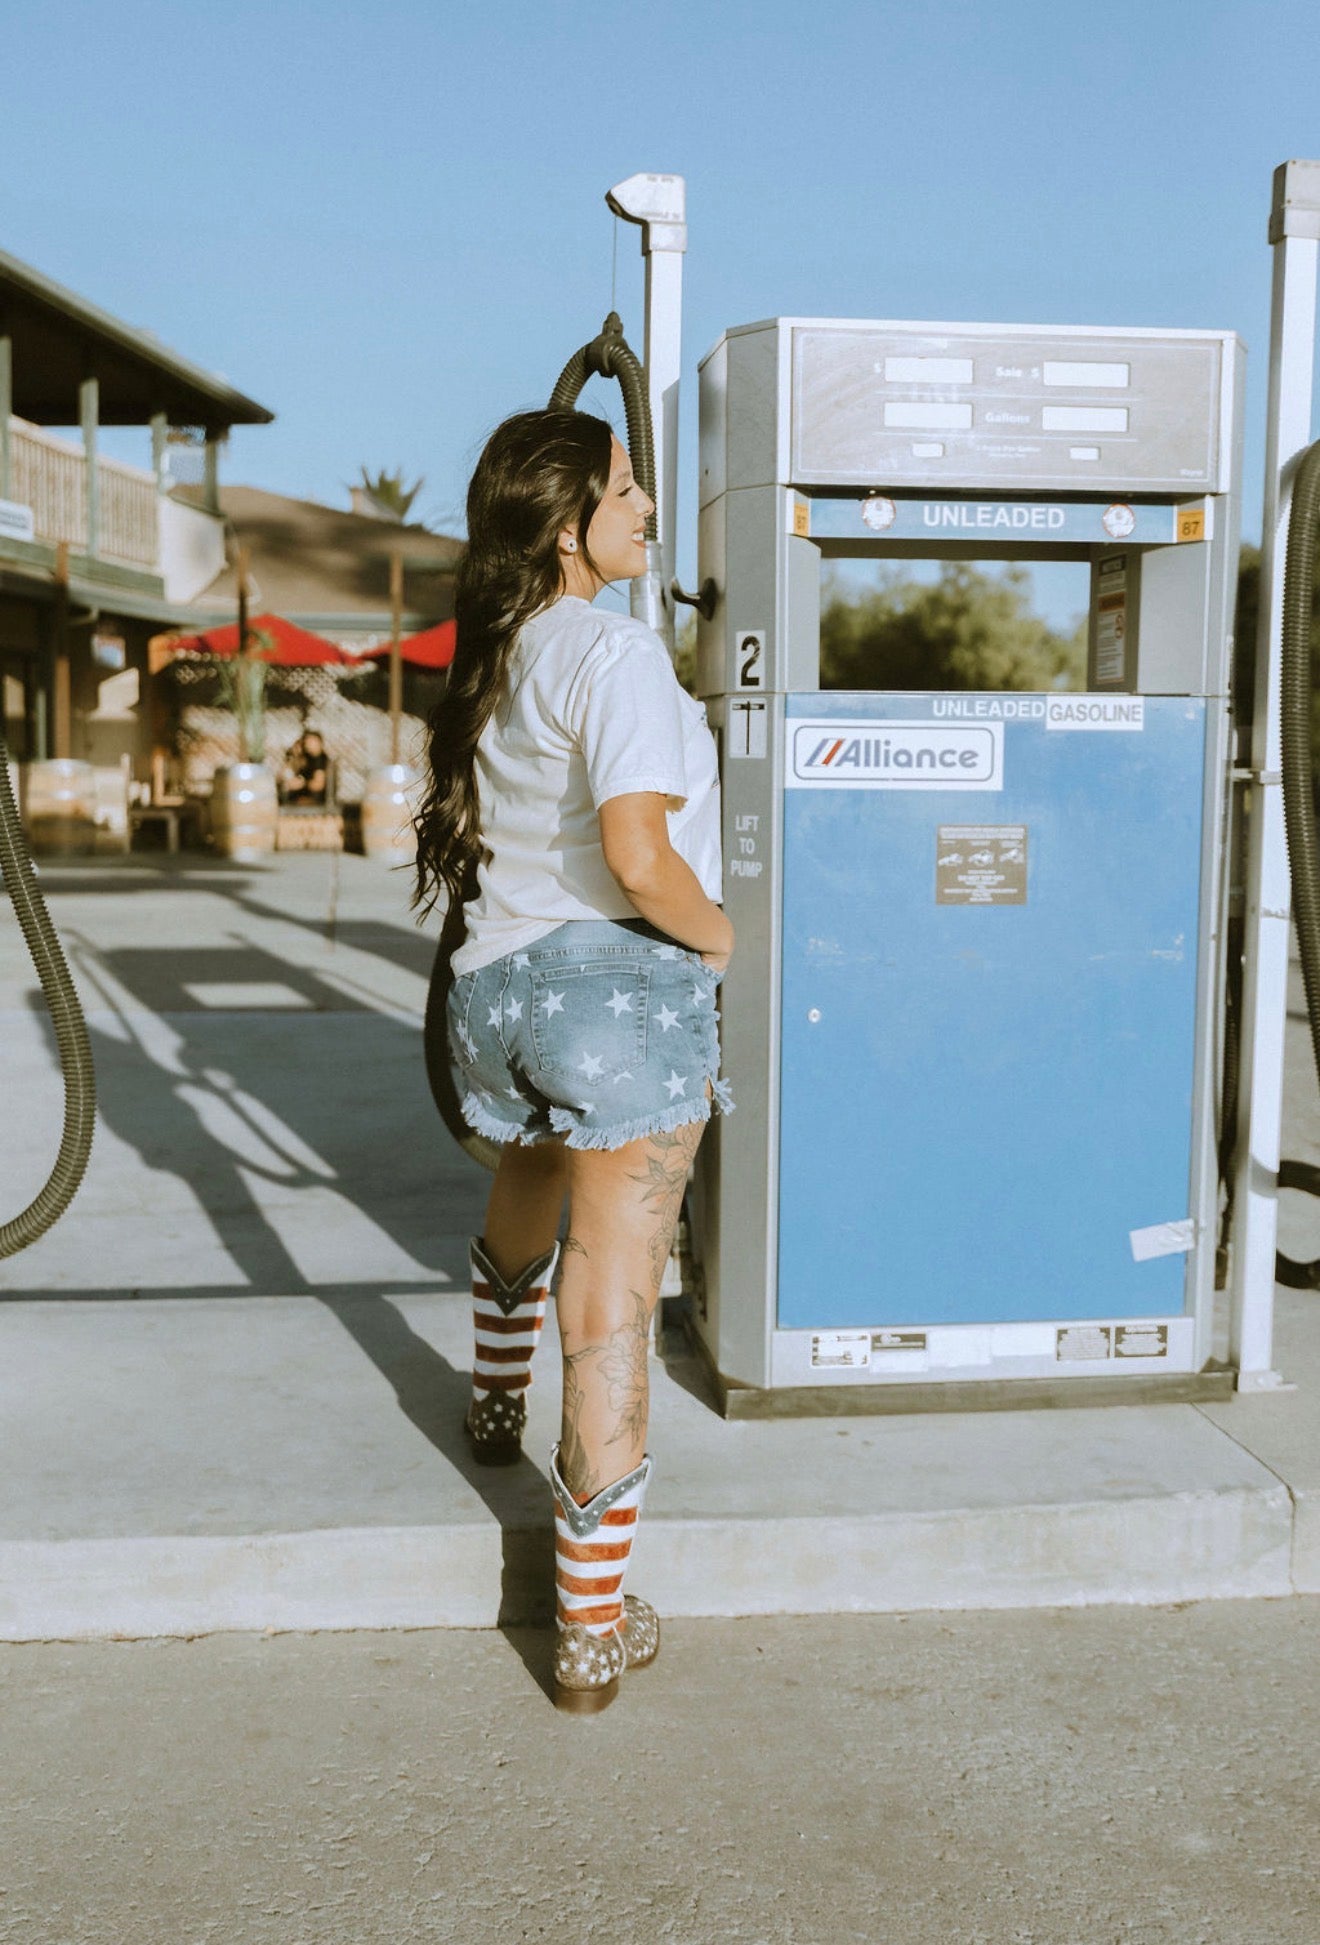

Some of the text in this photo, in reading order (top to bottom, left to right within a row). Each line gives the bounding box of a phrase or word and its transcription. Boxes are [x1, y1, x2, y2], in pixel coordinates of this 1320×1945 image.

[923, 506, 1065, 529] UNLEADED
[1181, 521, 1200, 536] 87
[740, 635, 761, 686] 2
[932, 700, 1143, 723] UNLEADED GASOLINE
[834, 739, 979, 769] Alliance
[735, 815, 759, 832] LIFT
[739, 838, 755, 855] TO
[730, 860, 763, 878] PUMP
